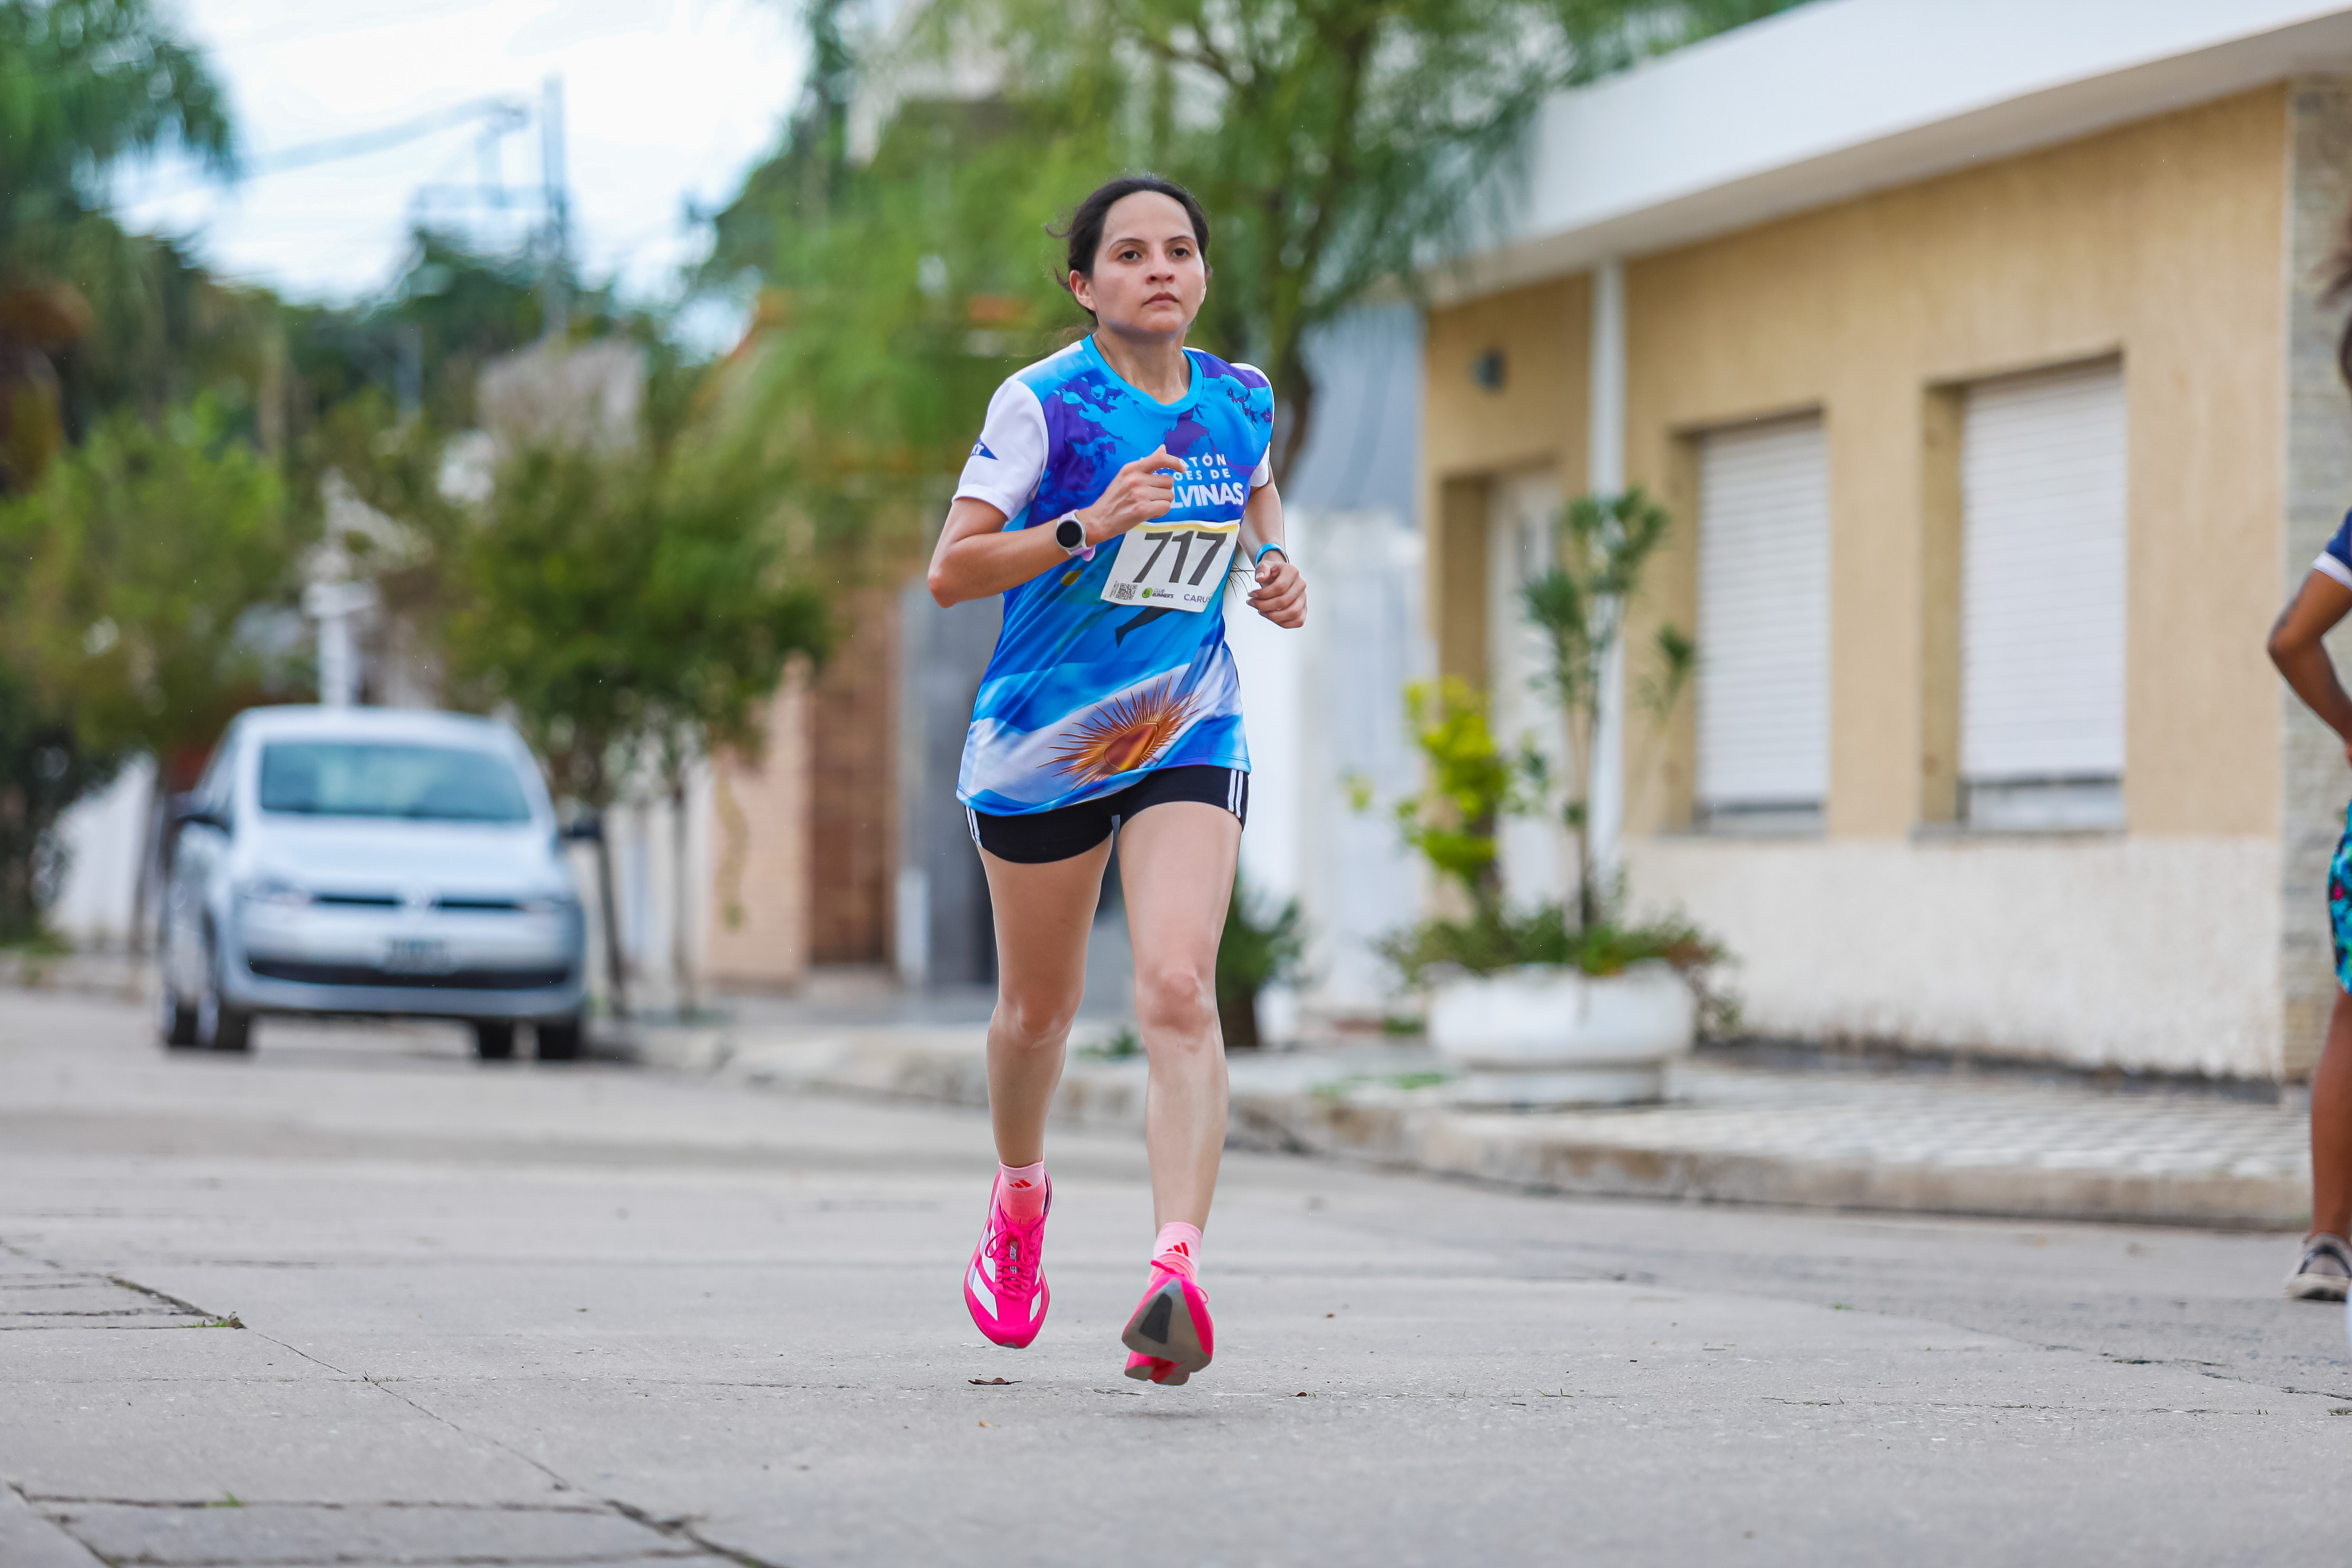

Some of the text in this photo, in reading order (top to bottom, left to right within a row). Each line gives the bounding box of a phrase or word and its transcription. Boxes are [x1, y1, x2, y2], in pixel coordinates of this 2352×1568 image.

[1179, 453, 1227, 468] ATÓN
[1173, 468, 1231, 481] OES DE
[1170, 482, 1244, 508] LVINAS
[1133, 531, 1228, 586] 717
